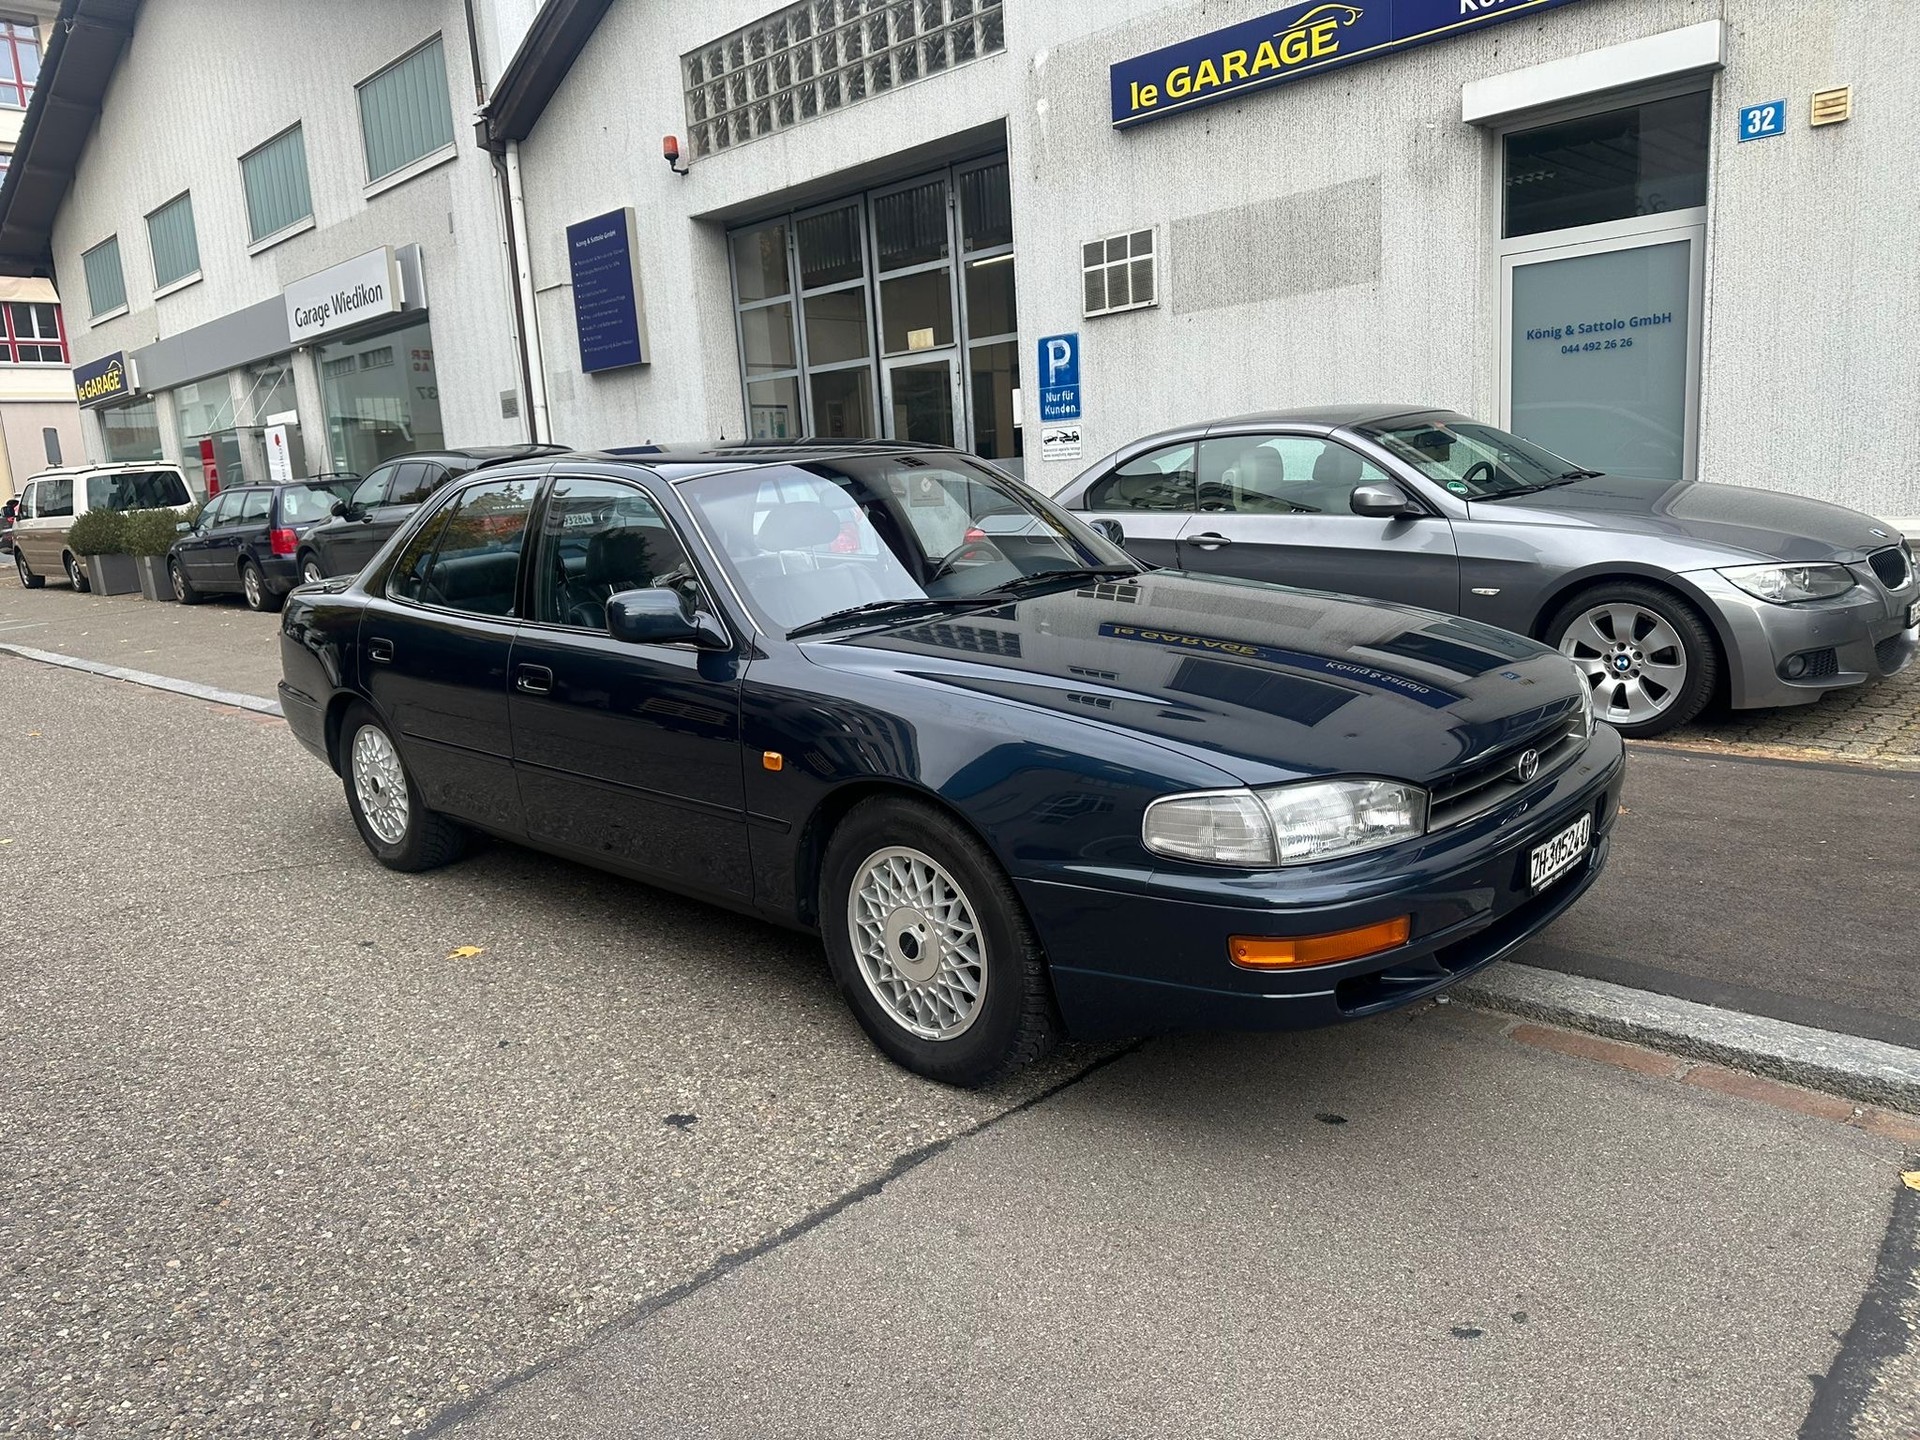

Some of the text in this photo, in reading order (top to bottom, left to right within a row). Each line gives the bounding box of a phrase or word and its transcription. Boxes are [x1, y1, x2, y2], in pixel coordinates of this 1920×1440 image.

[1130, 21, 1340, 110] le GARAGE
[1747, 106, 1775, 134] 32
[294, 283, 384, 327] Garage Wiedikon
[1526, 312, 1673, 340] König & Sattolo GmbH
[1561, 337, 1634, 354] 044 492 26 26
[1047, 339, 1072, 385] P
[77, 370, 122, 401] le GARAGE
[1045, 390, 1075, 402] Nur für
[1044, 403, 1076, 415] Kunden
